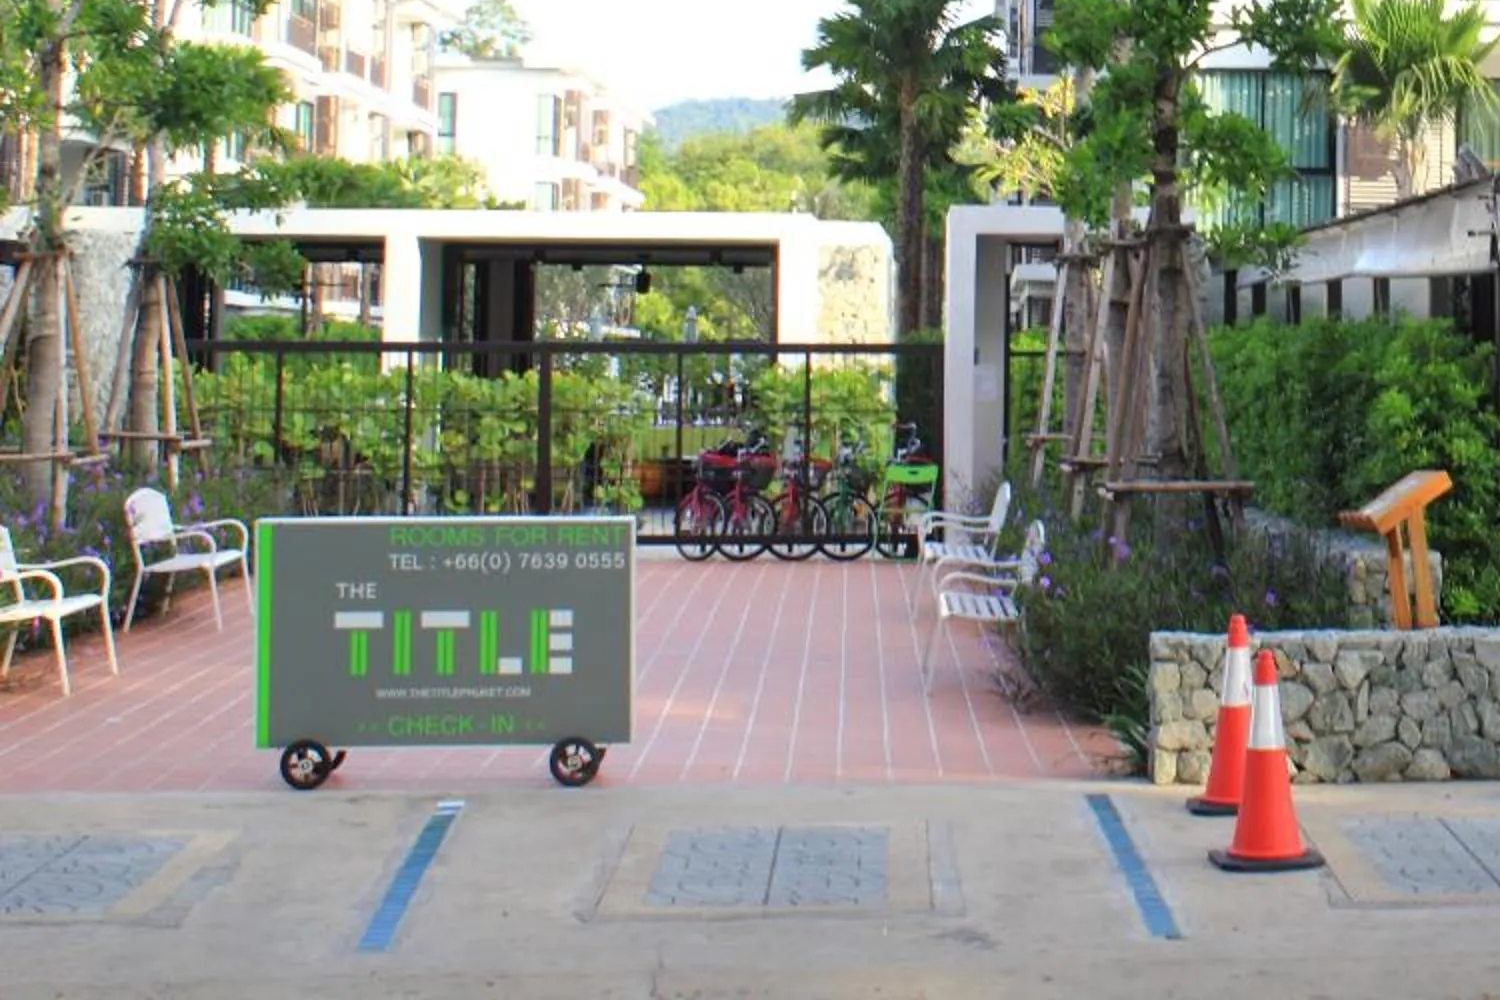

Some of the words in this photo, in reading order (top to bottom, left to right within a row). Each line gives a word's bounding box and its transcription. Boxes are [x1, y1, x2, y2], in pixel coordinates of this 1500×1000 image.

[389, 525, 484, 547] ROOMS
[495, 525, 548, 547] FOR
[557, 525, 627, 546] RENT
[388, 553, 422, 570] TEL
[443, 552, 511, 574] +66(0)
[519, 552, 568, 570] 7639
[575, 552, 626, 570] 0555
[335, 583, 377, 599] THE
[334, 609, 573, 677] TITLE
